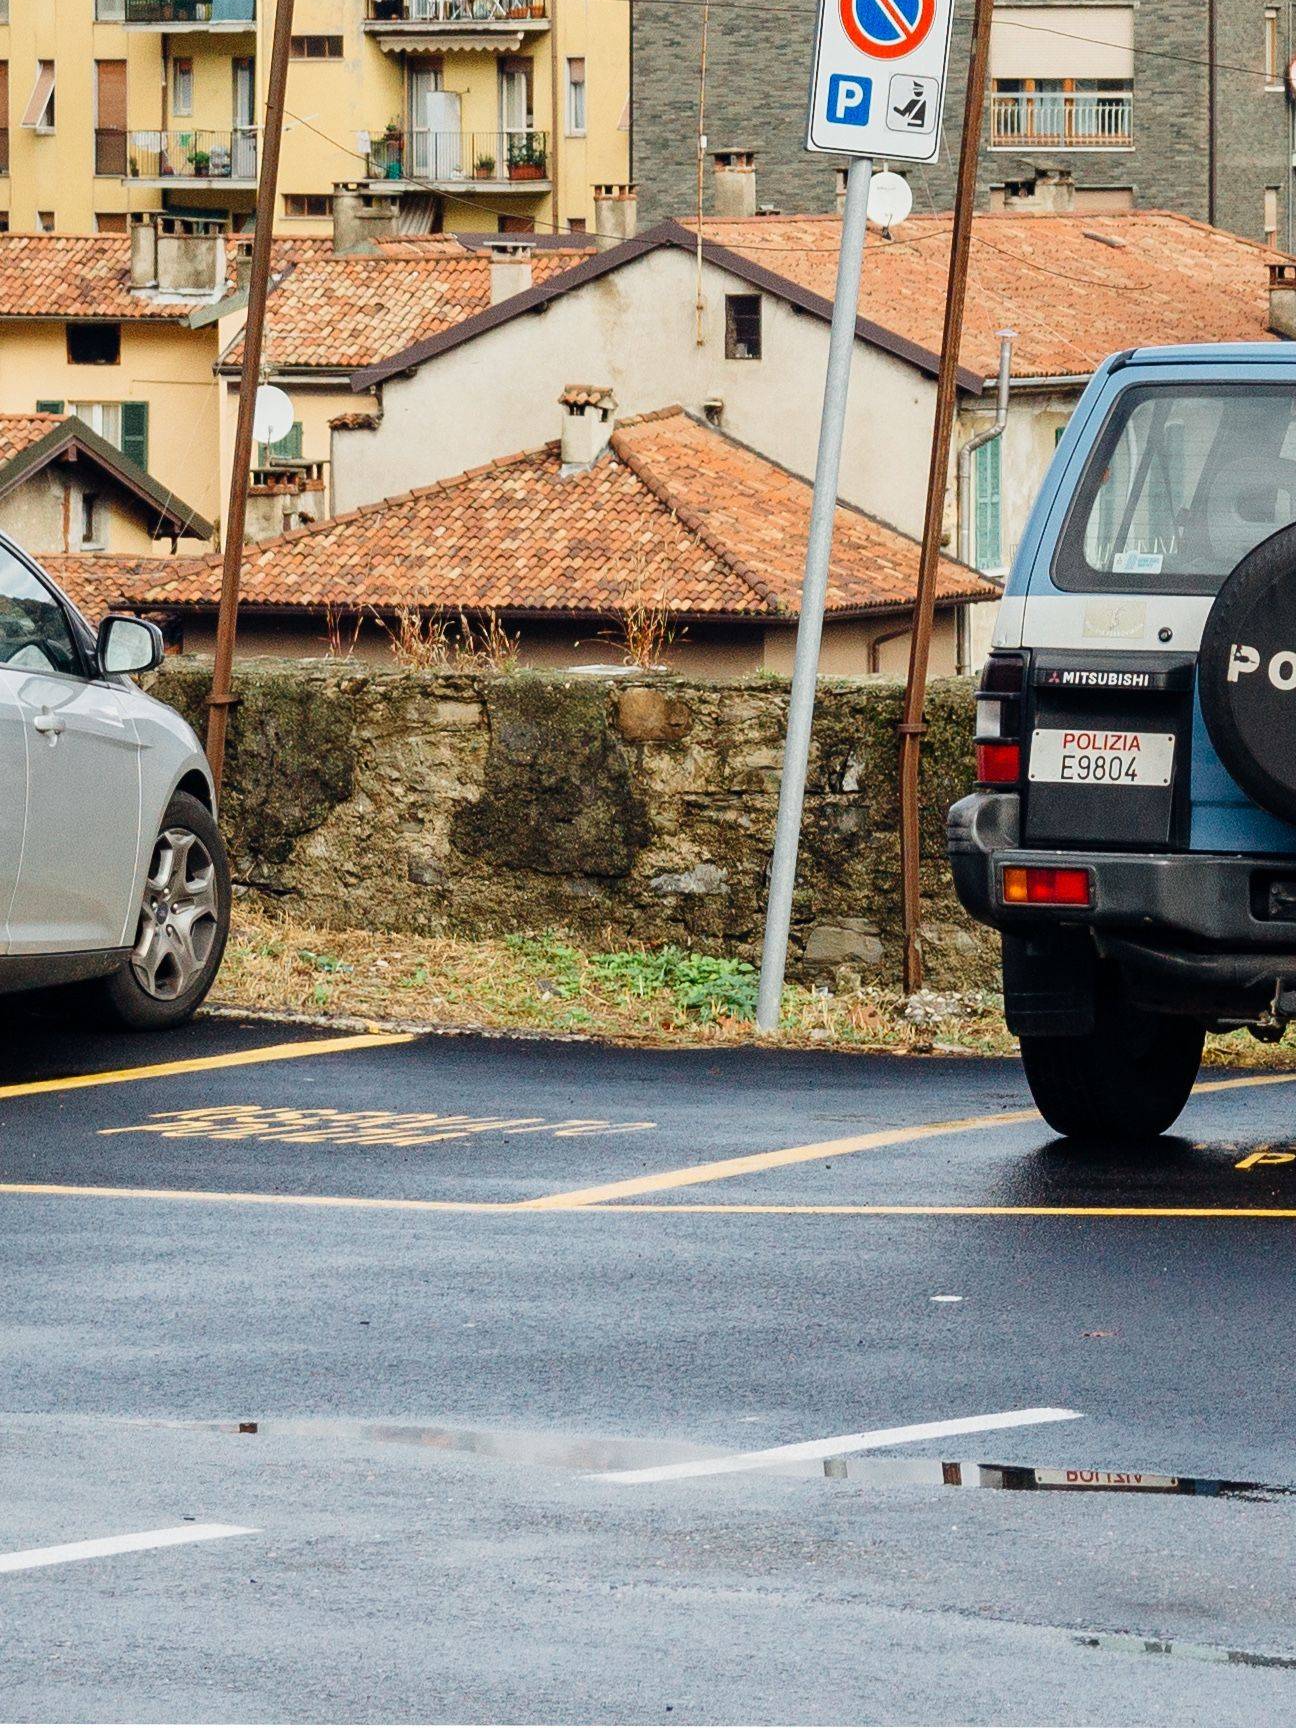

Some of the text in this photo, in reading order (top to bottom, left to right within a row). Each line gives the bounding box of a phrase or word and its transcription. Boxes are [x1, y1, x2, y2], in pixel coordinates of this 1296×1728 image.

[836, 81, 863, 118] P
[1062, 671, 1149, 687] MITSUBISHI
[1062, 733, 1141, 752] POLIZIA
[1060, 754, 1138, 782] E9804
[98, 1120, 470, 1147] POLIZIA
